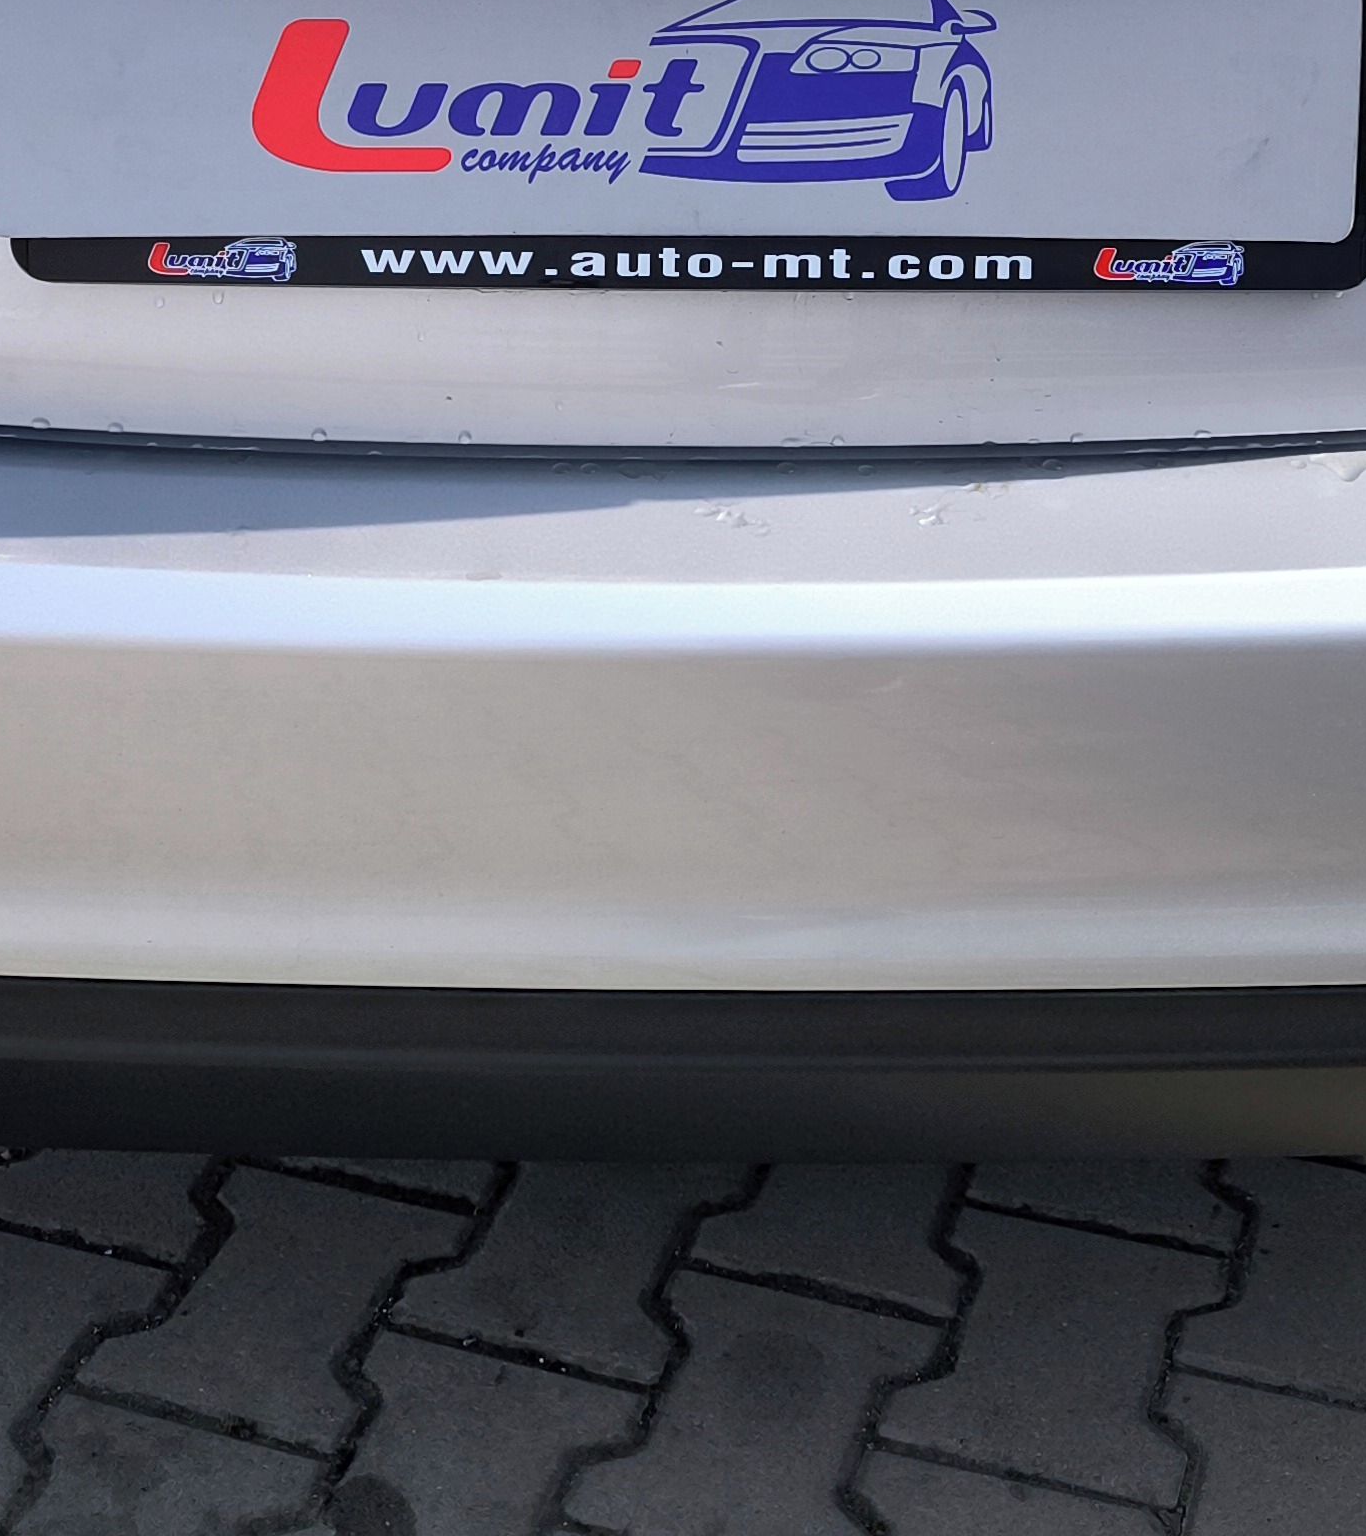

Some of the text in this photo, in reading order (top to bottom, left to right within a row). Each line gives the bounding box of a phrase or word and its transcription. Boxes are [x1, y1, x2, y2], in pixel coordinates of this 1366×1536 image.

[251, 18, 705, 173] Lumit
[460, 143, 631, 185] company
[148, 242, 241, 276] Lumit
[360, 246, 1034, 280] www.auto-mt.com
[1093, 247, 1187, 281] Lumit
